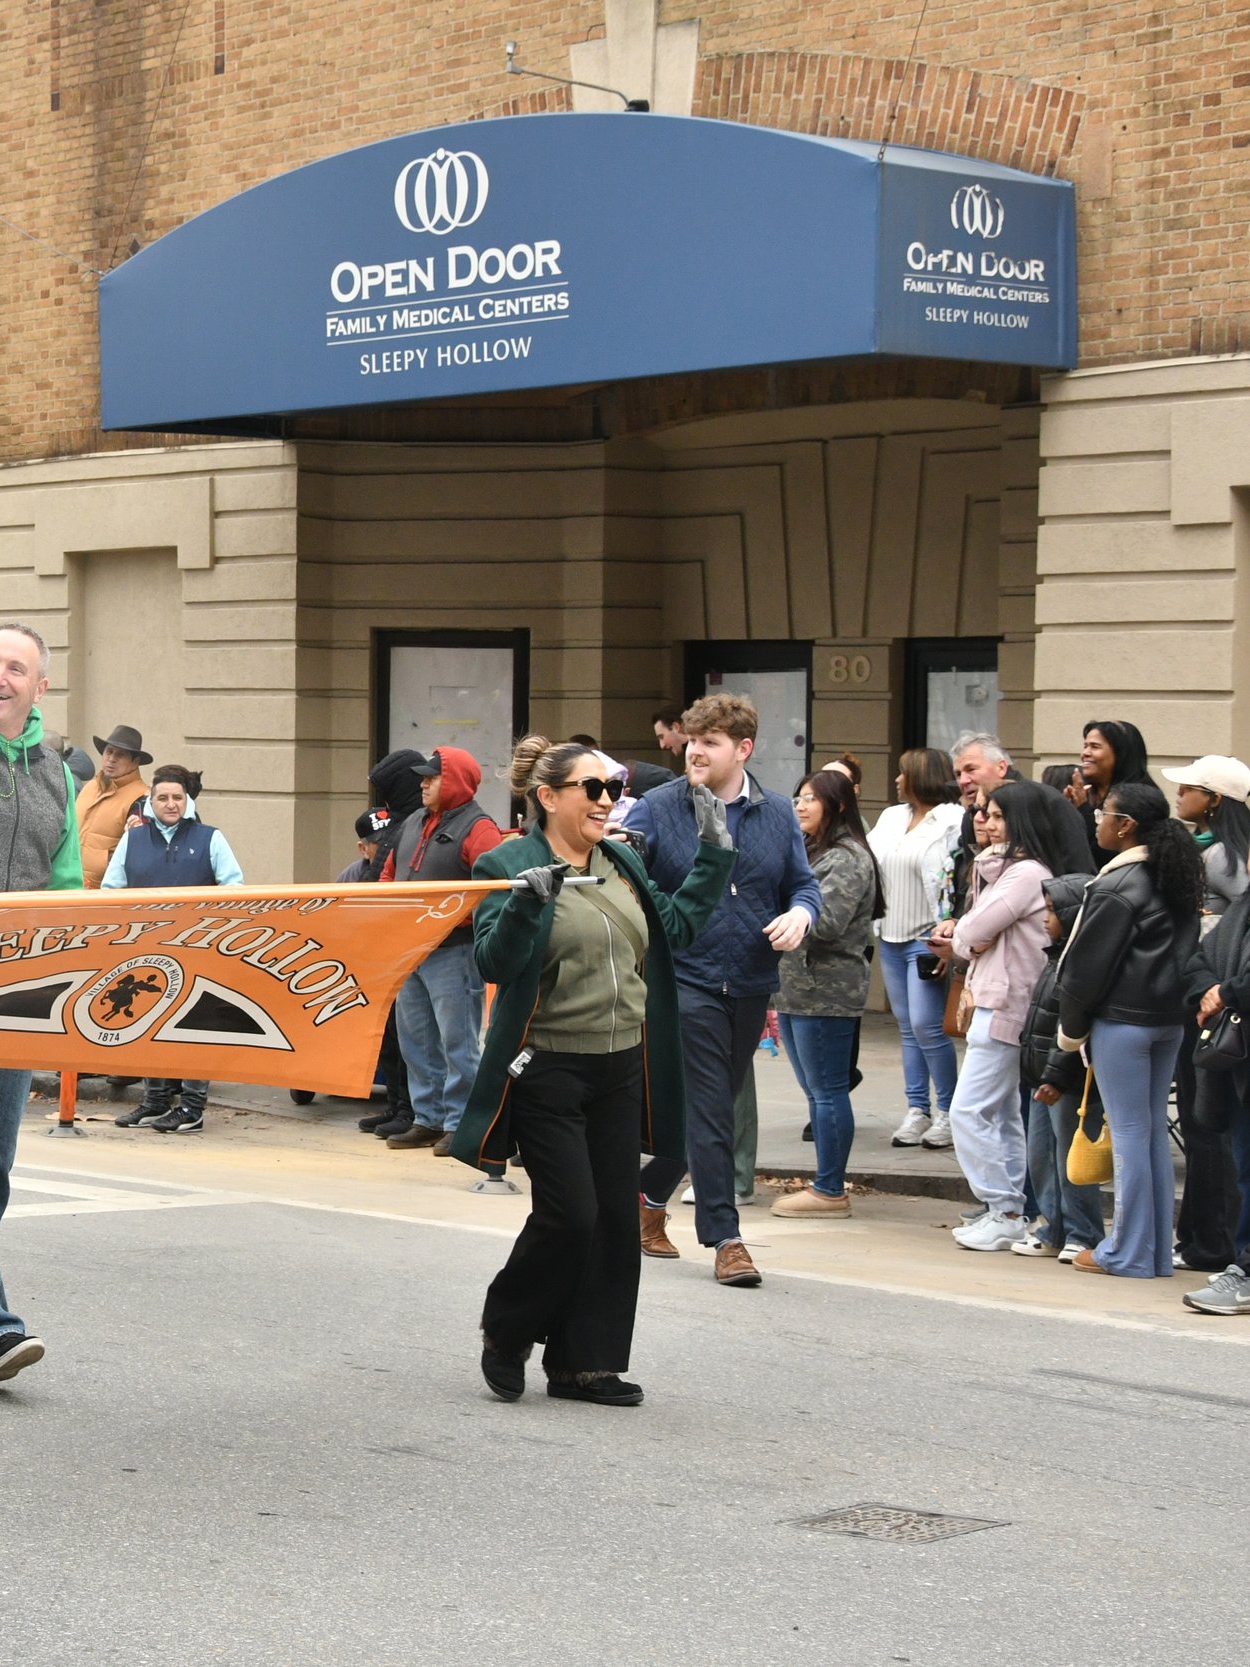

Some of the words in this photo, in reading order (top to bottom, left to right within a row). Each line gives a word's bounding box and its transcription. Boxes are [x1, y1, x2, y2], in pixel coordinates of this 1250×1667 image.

[330, 256, 436, 303] OPEN
[447, 240, 562, 289] DOOR
[907, 241, 974, 275] OPEN
[980, 251, 1046, 282] DOOR
[903, 278, 943, 295] FAMILY
[946, 281, 997, 300] MEDICAL
[998, 286, 1050, 303] CENTERS
[326, 313, 388, 338] FAMILY
[392, 303, 475, 330] MEDICAL
[478, 291, 569, 320] CENTERS
[925, 306, 969, 323] SLEEPY
[973, 311, 1030, 329] HOLLOW
[360, 348, 428, 375] SLEEPY
[436, 336, 533, 368] HOLLOW
[830, 656, 871, 682] 80
[298, 896, 339, 916] of
[85, 967, 123, 997] VILLAGE
[126, 960, 140, 970] OF
[141, 957, 174, 971] SLEEPY
[164, 968, 181, 1000] HOLLOW
[158, 916, 370, 1027] HOLLOW
[97, 1032, 120, 1042] 1874
